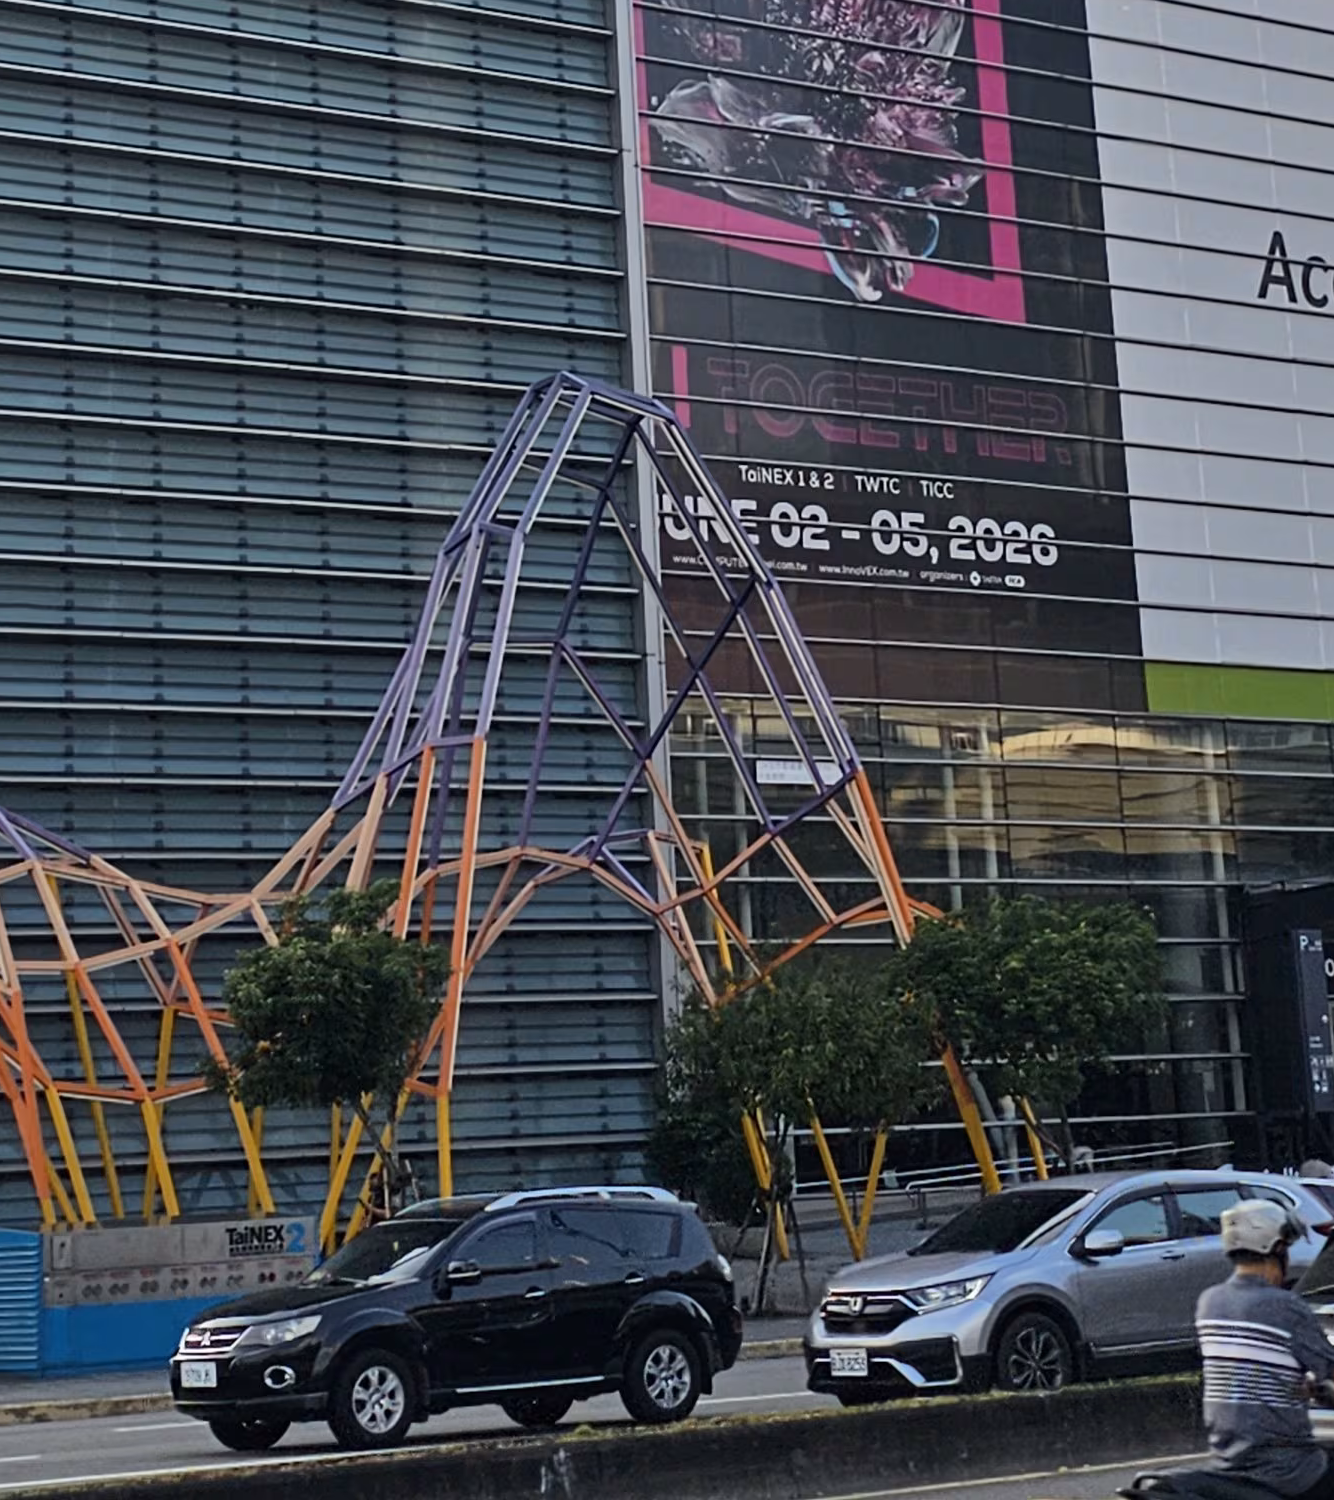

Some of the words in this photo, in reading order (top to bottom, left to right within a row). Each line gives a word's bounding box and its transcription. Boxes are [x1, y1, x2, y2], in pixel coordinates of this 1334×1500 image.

[671, 343, 692, 429] I
[707, 356, 1072, 466] TOGETHER
[738, 465, 795, 485] TaiNEX
[797, 471, 806, 487] 1
[809, 471, 821, 489] &
[823, 472, 835, 490] 2
[855, 475, 900, 495] TWTC
[919, 480, 955, 499] TICC
[658, 494, 760, 545] UNE
[769, 502, 831, 551] 02
[871, 508, 940, 565] 05,
[947, 514, 1059, 567] 2026
[225, 1224, 285, 1246] TaiNEX
[285, 1221, 305, 1253] 2
